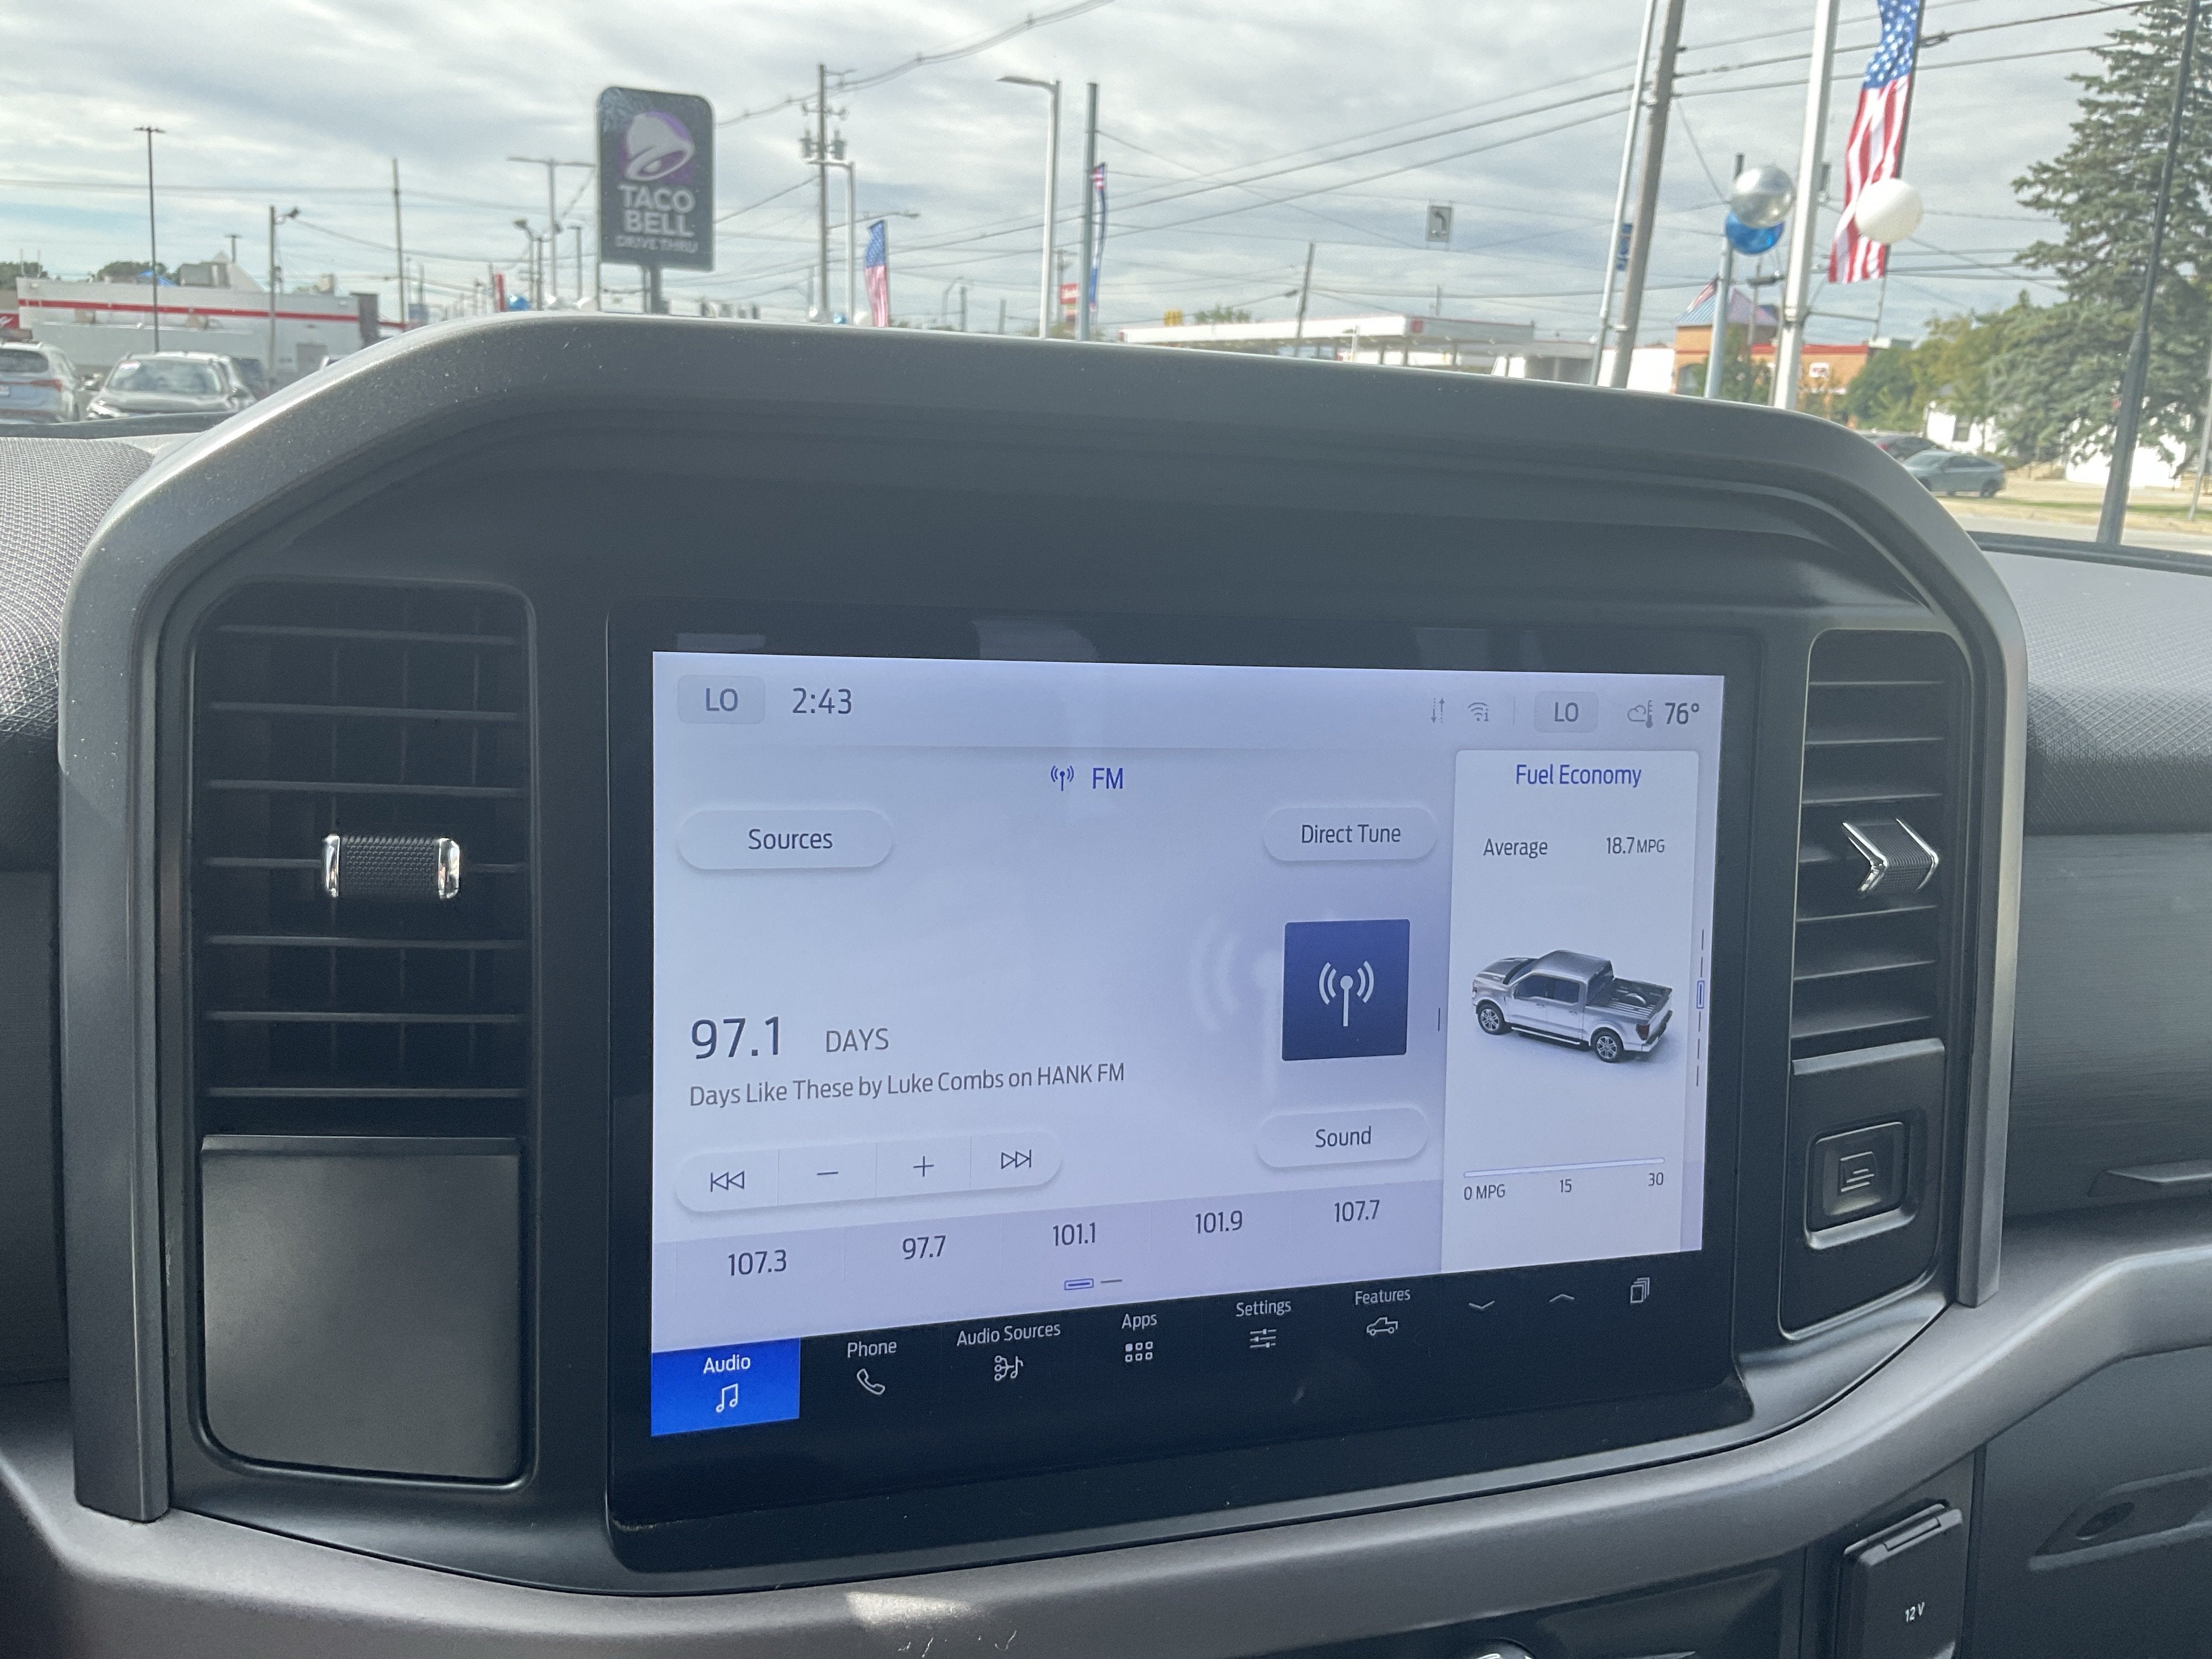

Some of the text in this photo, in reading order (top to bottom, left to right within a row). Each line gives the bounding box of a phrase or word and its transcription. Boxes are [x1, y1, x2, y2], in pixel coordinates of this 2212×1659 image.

[617, 184, 696, 213] TACO
[623, 209, 695, 237] BELL
[614, 235, 657, 249] DRIVE
[706, 687, 738, 712] LO
[792, 687, 851, 714] 2:43
[1554, 702, 1579, 723] LO
[1092, 768, 1123, 789] FM
[1516, 764, 1642, 788] Fuel Economy
[748, 828, 833, 850] Sources
[1302, 824, 1401, 843] Direct Tune
[1483, 838, 1548, 859] Average
[691, 1016, 778, 1059] 97.1
[826, 1028, 889, 1053] DAYS
[690, 1062, 1124, 1108] Days Like These by Luke Combs on HANK FM
[1315, 1125, 1372, 1148] Sound
[1560, 1178, 1572, 1193] 15
[1648, 1172, 1664, 1186] 30
[1464, 1183, 1505, 1200] 0 MPG
[1334, 1199, 1380, 1222] 107.7
[1195, 1210, 1243, 1234] 101.9
[1053, 1222, 1096, 1246] 101.1
[902, 1235, 946, 1260] 97.7
[728, 1249, 787, 1276] 107.3
[1355, 1289, 1410, 1305] Features
[1235, 1301, 1291, 1317] Settings
[1121, 1313, 1157, 1331] Apps
[956, 1324, 1061, 1346] Audio Sources
[847, 1341, 897, 1358] Phone
[703, 1354, 751, 1374] Audio
